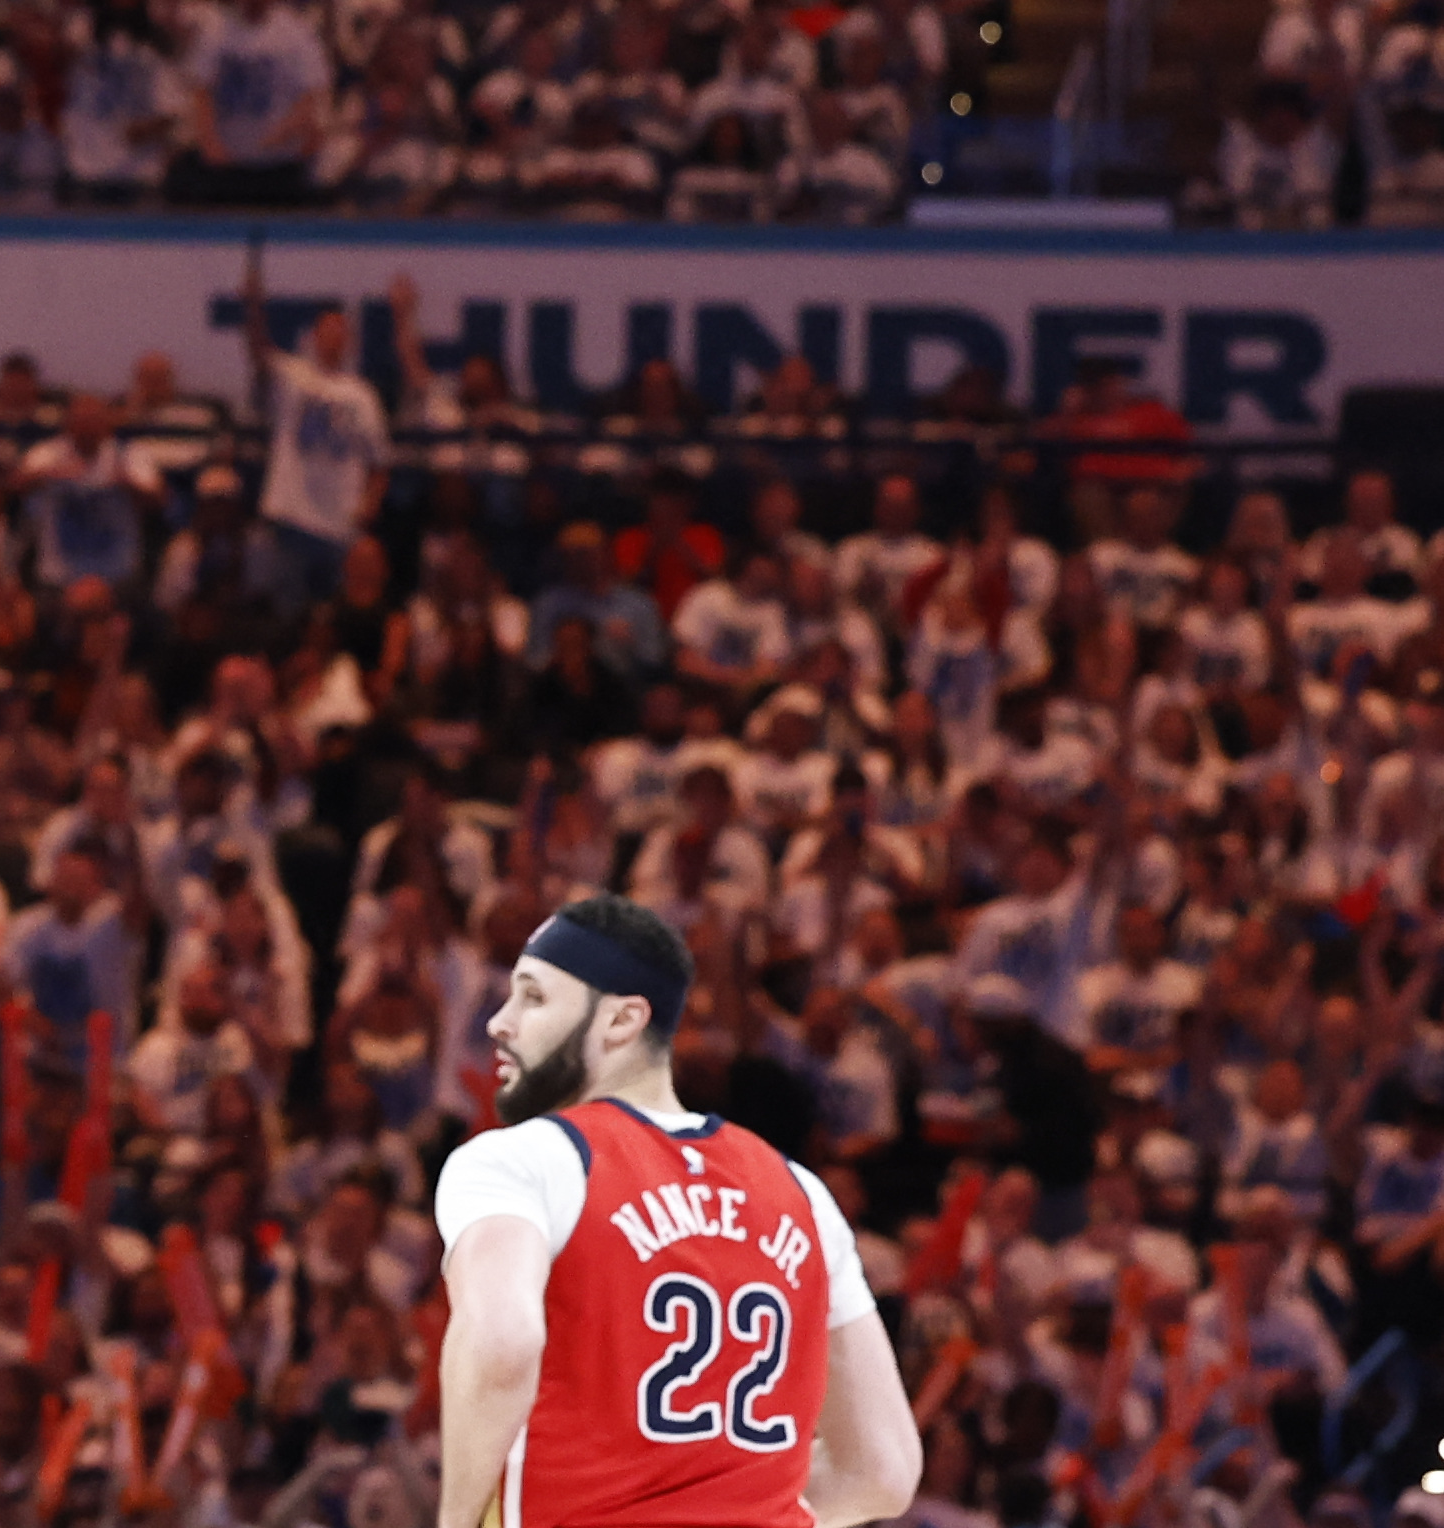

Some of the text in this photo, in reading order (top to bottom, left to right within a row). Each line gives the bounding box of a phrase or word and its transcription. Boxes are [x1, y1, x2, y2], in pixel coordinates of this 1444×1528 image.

[209, 296, 1330, 426] THUNDER
[611, 1183, 747, 1263] NANCE
[637, 1271, 798, 1453] 22
